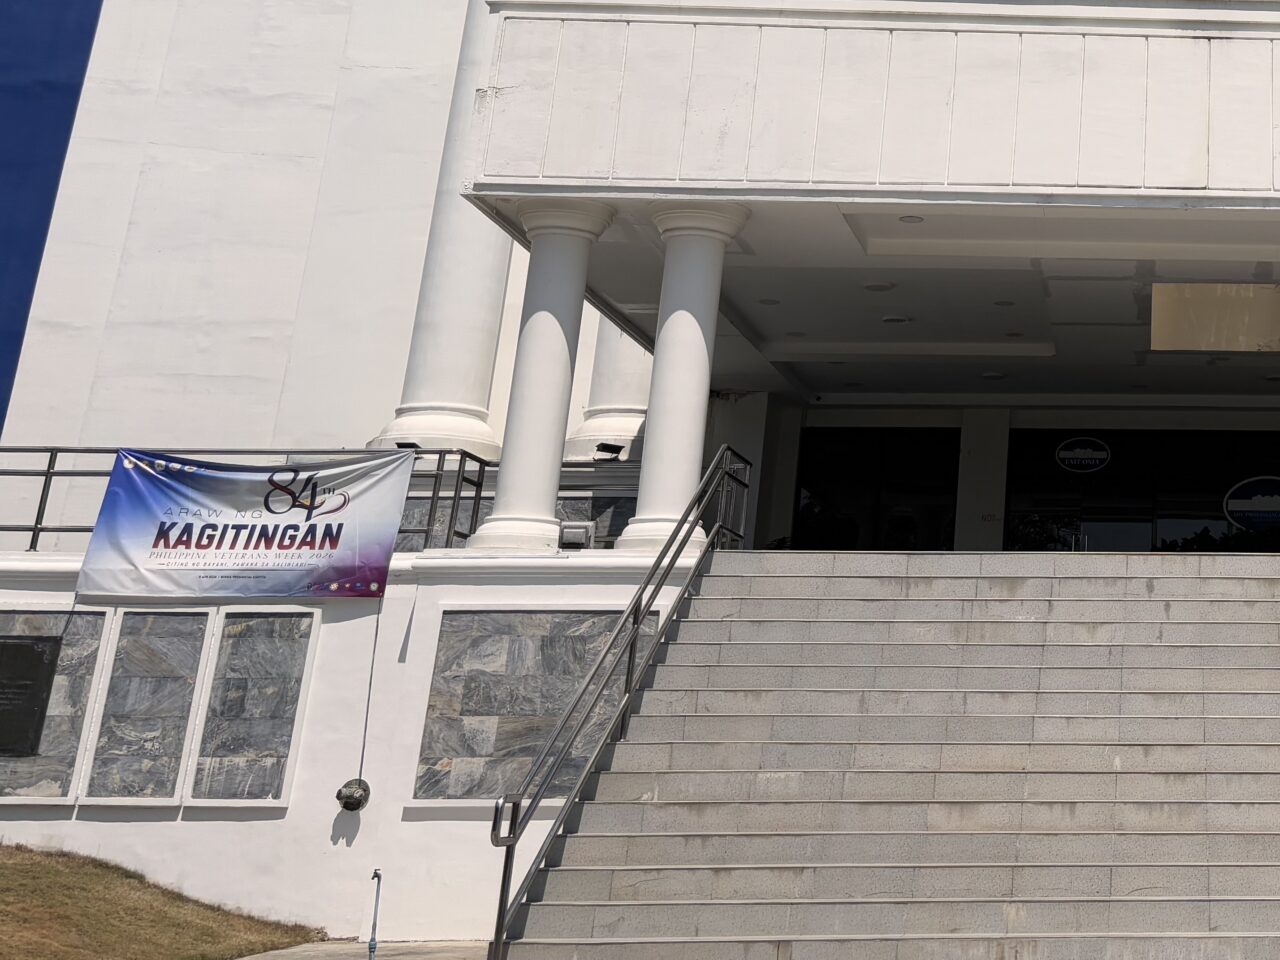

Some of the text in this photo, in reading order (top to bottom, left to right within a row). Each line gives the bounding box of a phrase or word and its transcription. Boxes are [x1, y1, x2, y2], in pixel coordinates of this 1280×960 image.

[162, 506, 263, 520] ARAW NG
[152, 521, 344, 551] KAGITINGAN
[149, 551, 208, 560] PHILIPPINE
[214, 552, 269, 560] VETERANS
[275, 552, 304, 560] WEEK
